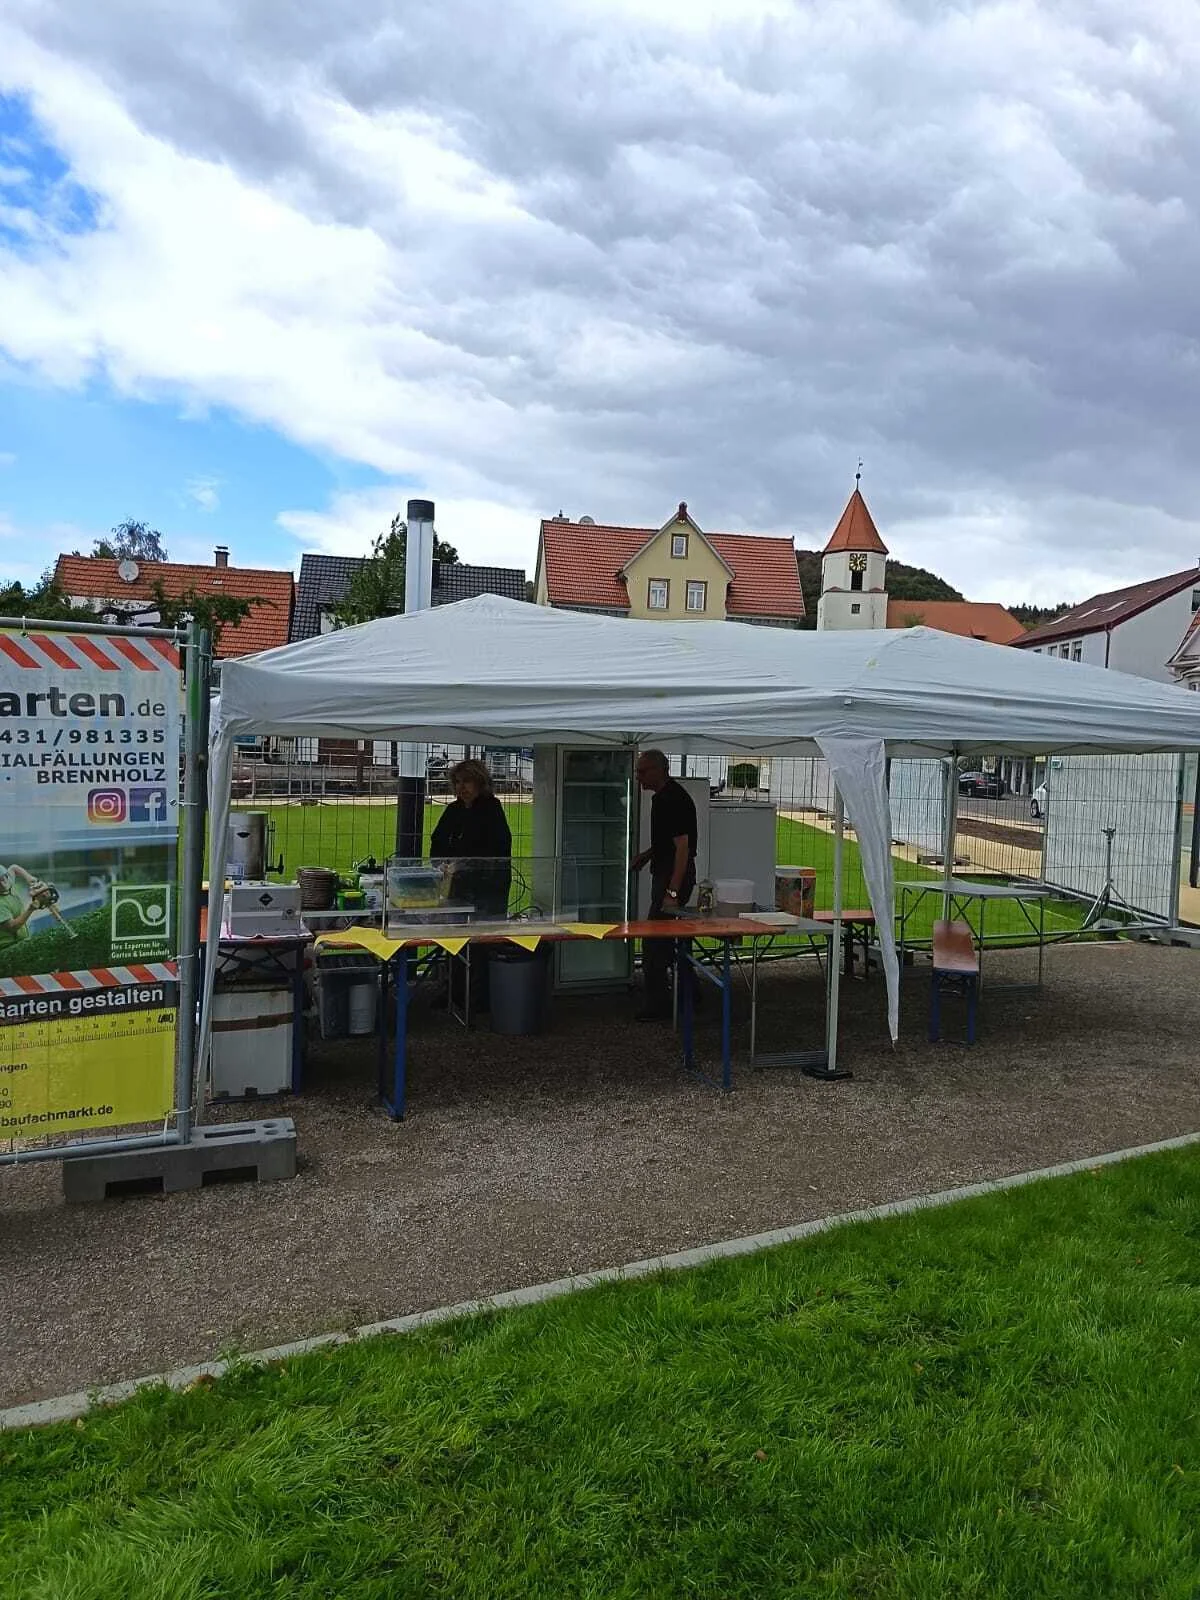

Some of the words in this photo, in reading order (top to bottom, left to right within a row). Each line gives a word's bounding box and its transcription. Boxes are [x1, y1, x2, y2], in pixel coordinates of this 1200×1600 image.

[0, 729, 165, 746] 431/981335
[1, 750, 165, 768] IALFÄLLUNGEN
[37, 768, 166, 784] BRENNHOLZ
[69, 988, 163, 1014] gestalten
[1, 1104, 113, 1127] baufachmarkt.de
